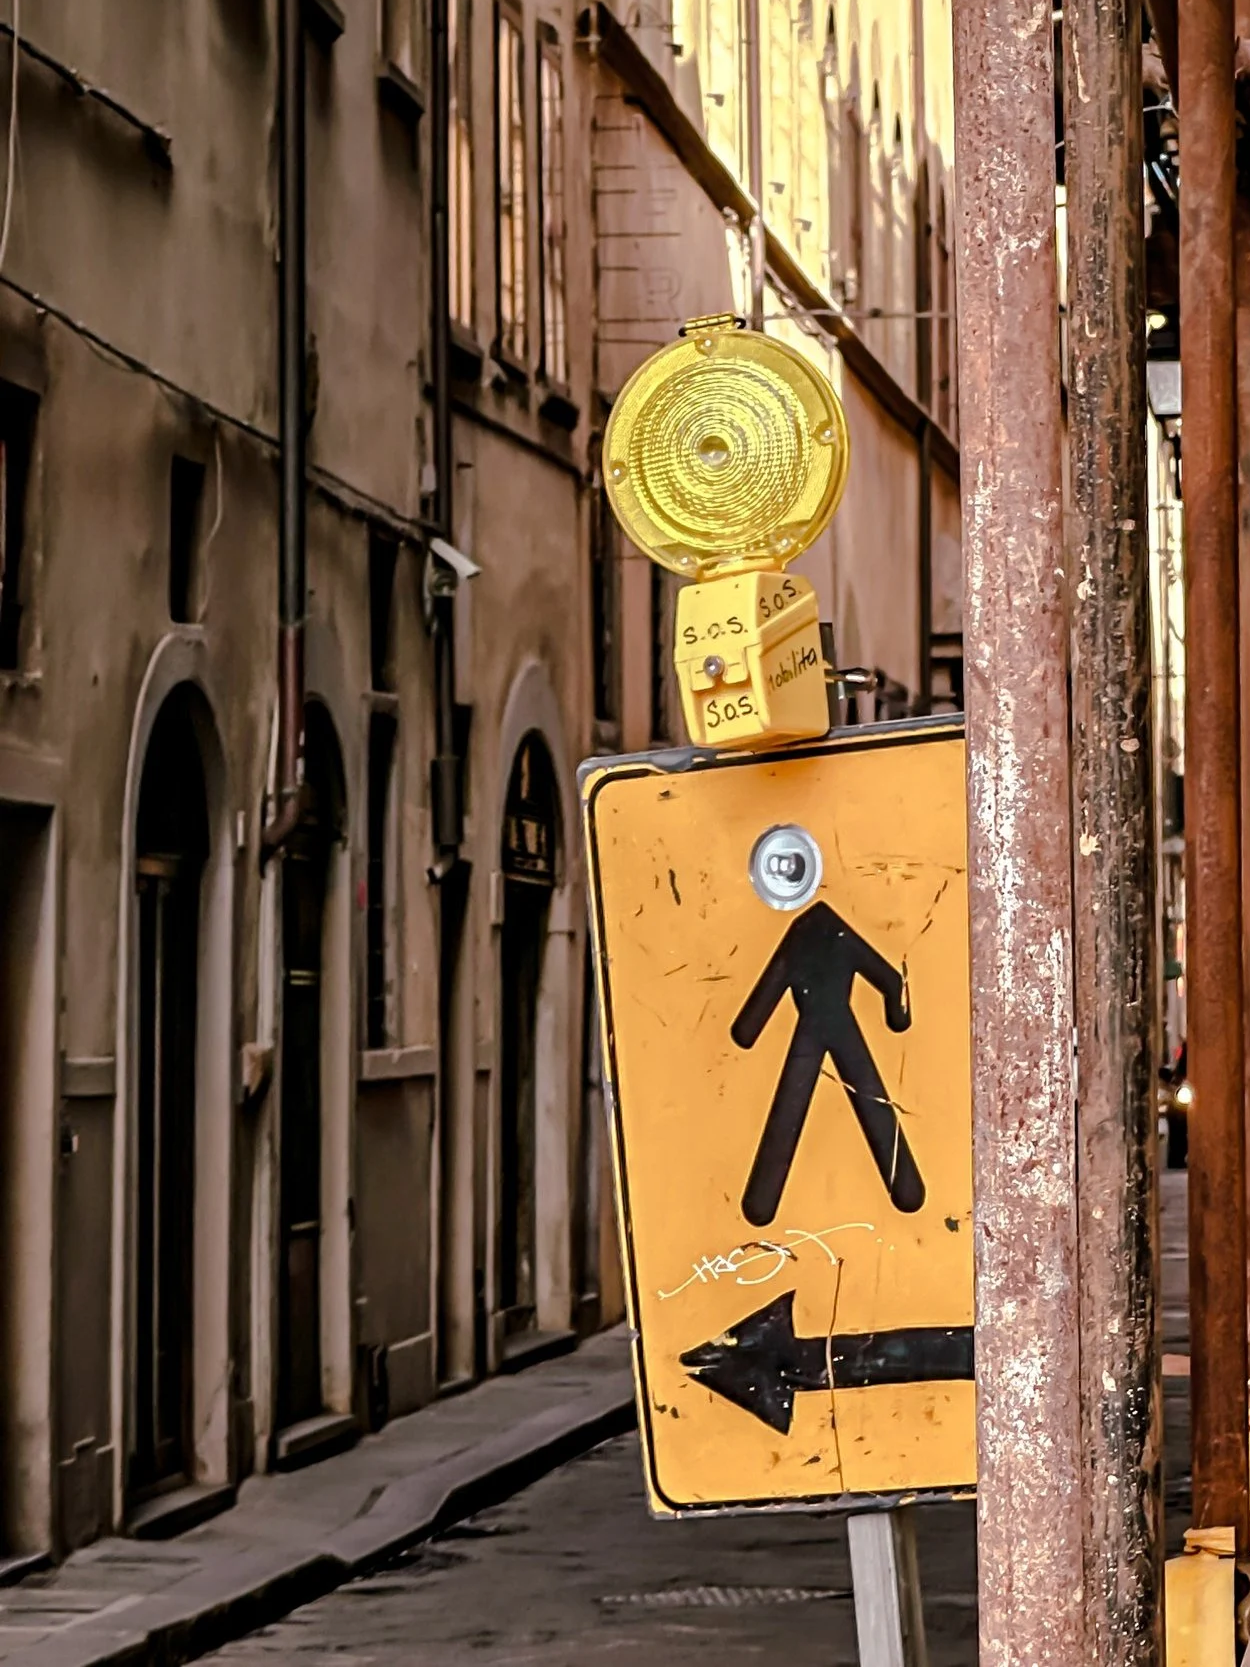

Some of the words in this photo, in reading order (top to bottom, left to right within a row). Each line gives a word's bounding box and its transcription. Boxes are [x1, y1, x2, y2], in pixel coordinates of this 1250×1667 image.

[759, 579, 802, 618] S.O.S.
[683, 616, 749, 645] S.O.S.
[706, 695, 759, 729] S.O.S.
